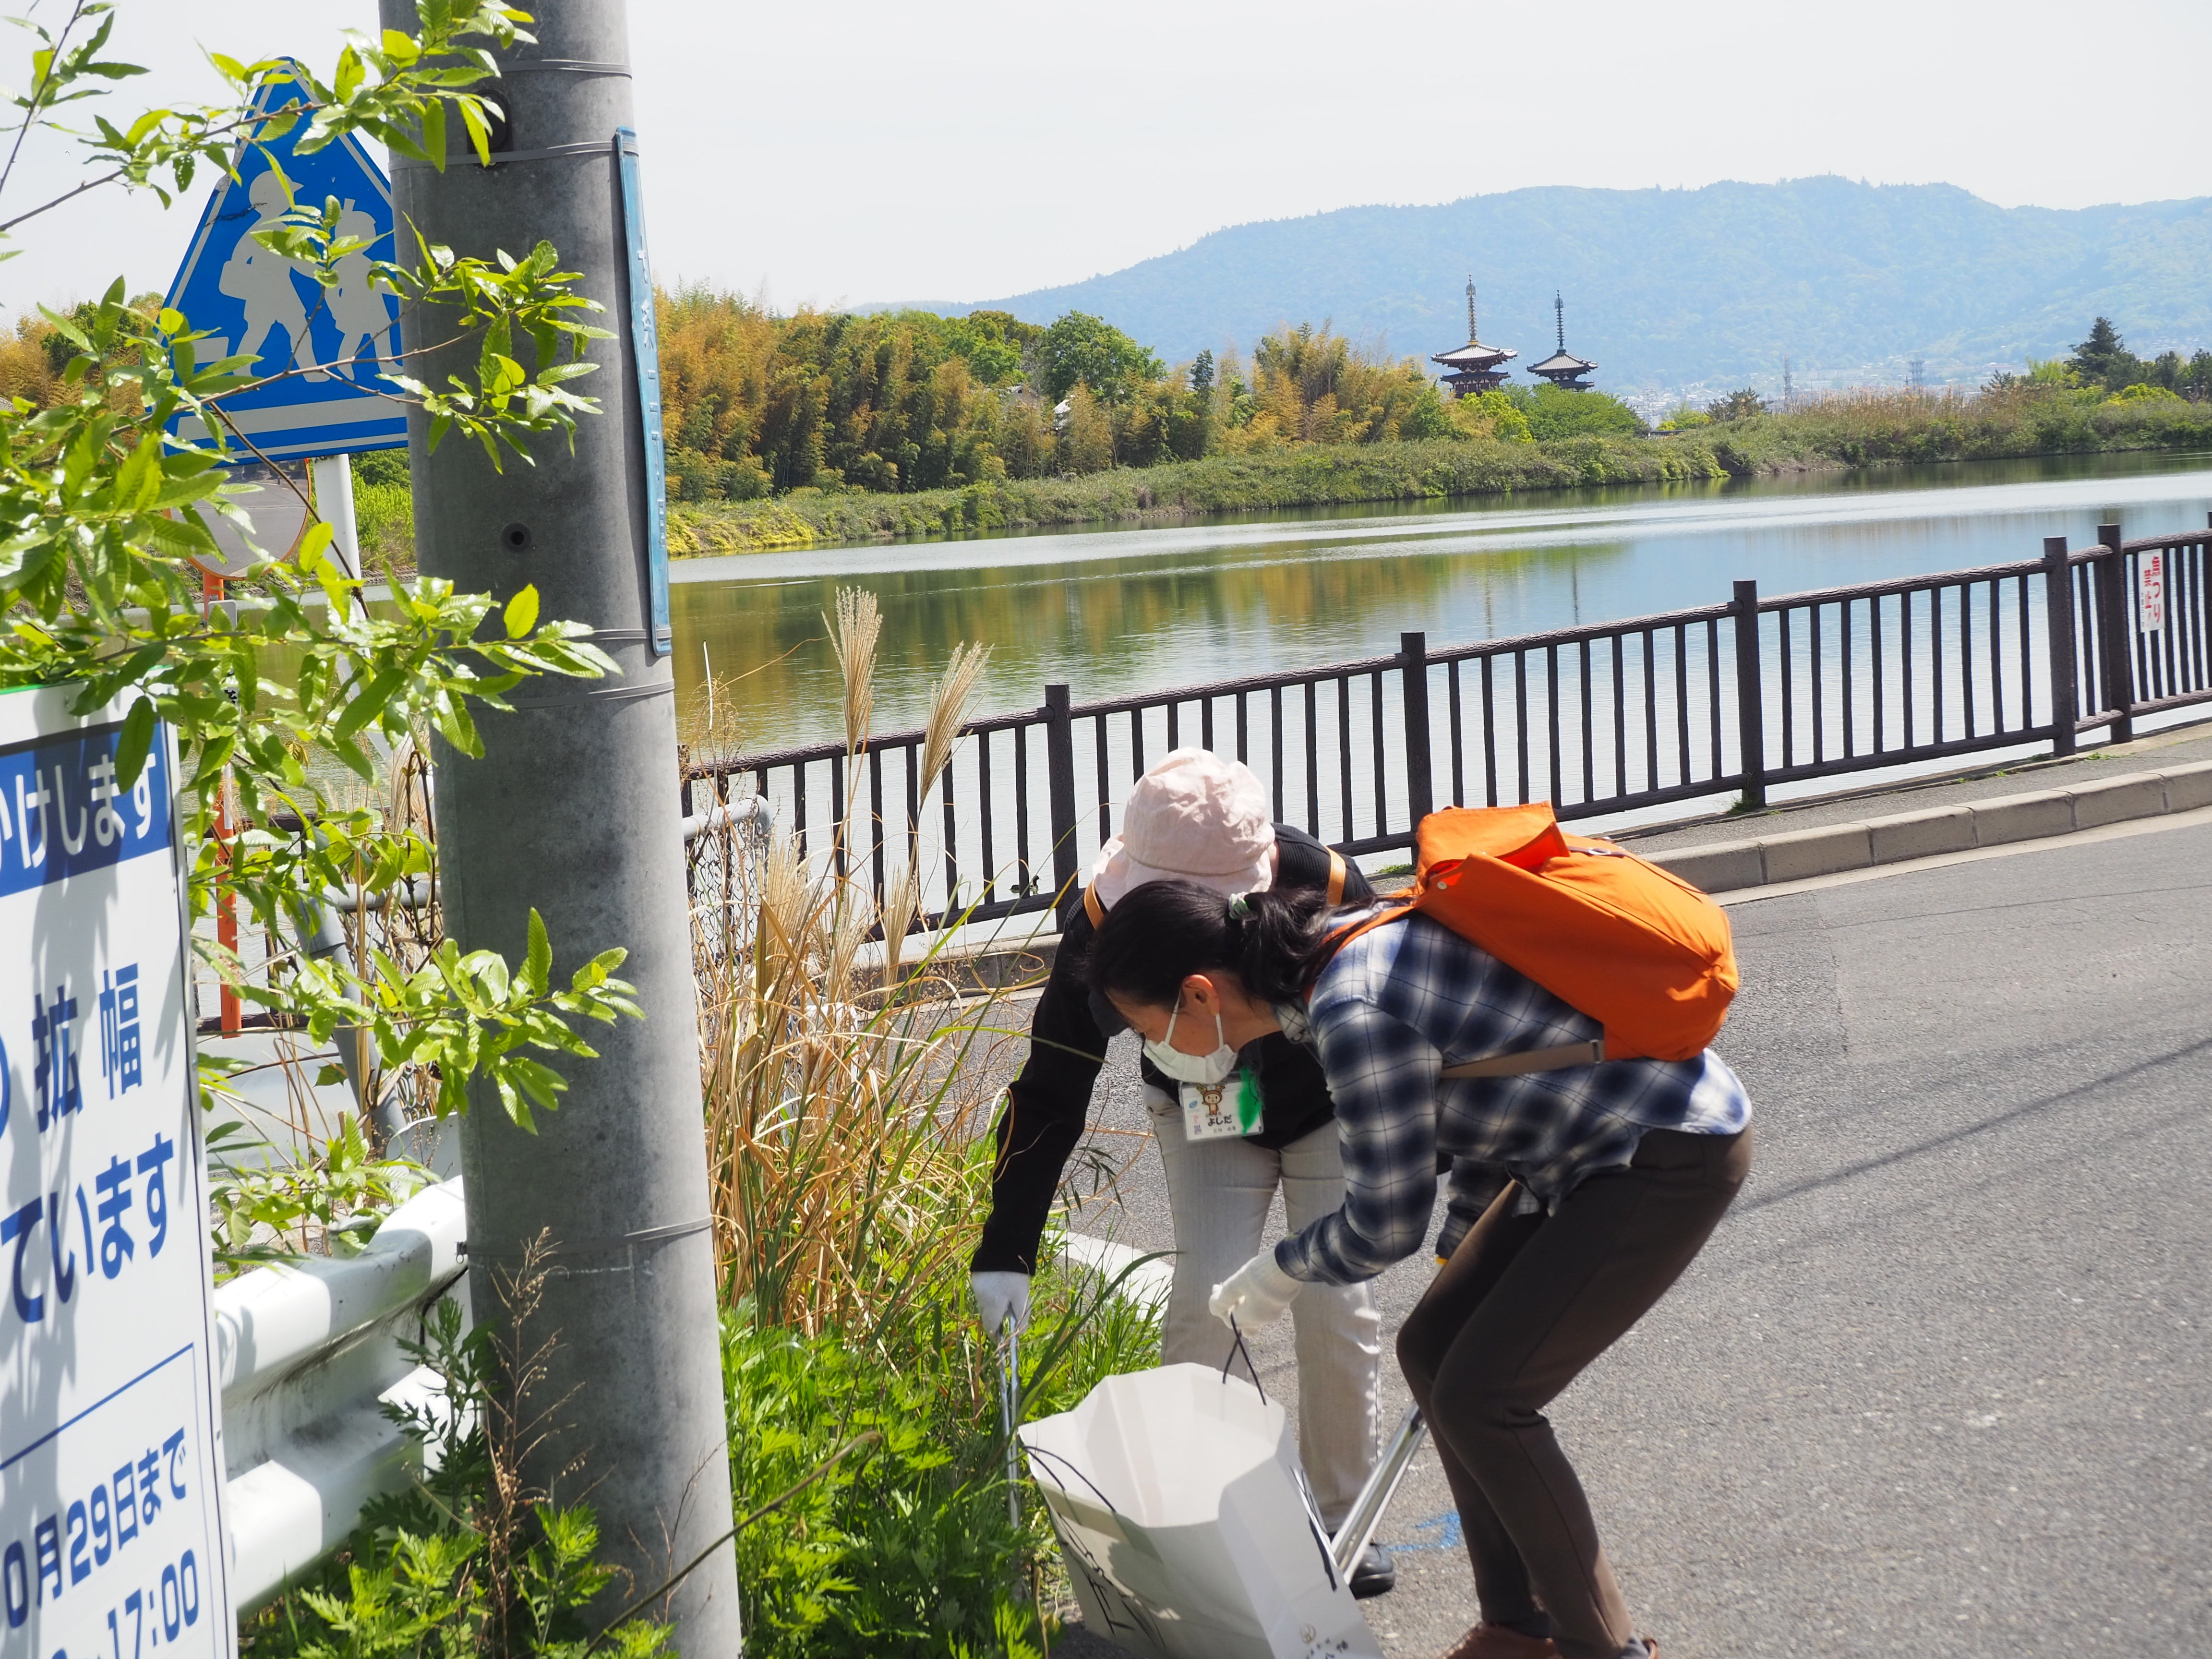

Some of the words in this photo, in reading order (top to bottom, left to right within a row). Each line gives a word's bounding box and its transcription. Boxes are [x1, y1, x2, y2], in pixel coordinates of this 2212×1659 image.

[0, 753, 156, 870] けします
[0, 962, 143, 1139] 拡幅
[0, 1132, 174, 1323] ています
